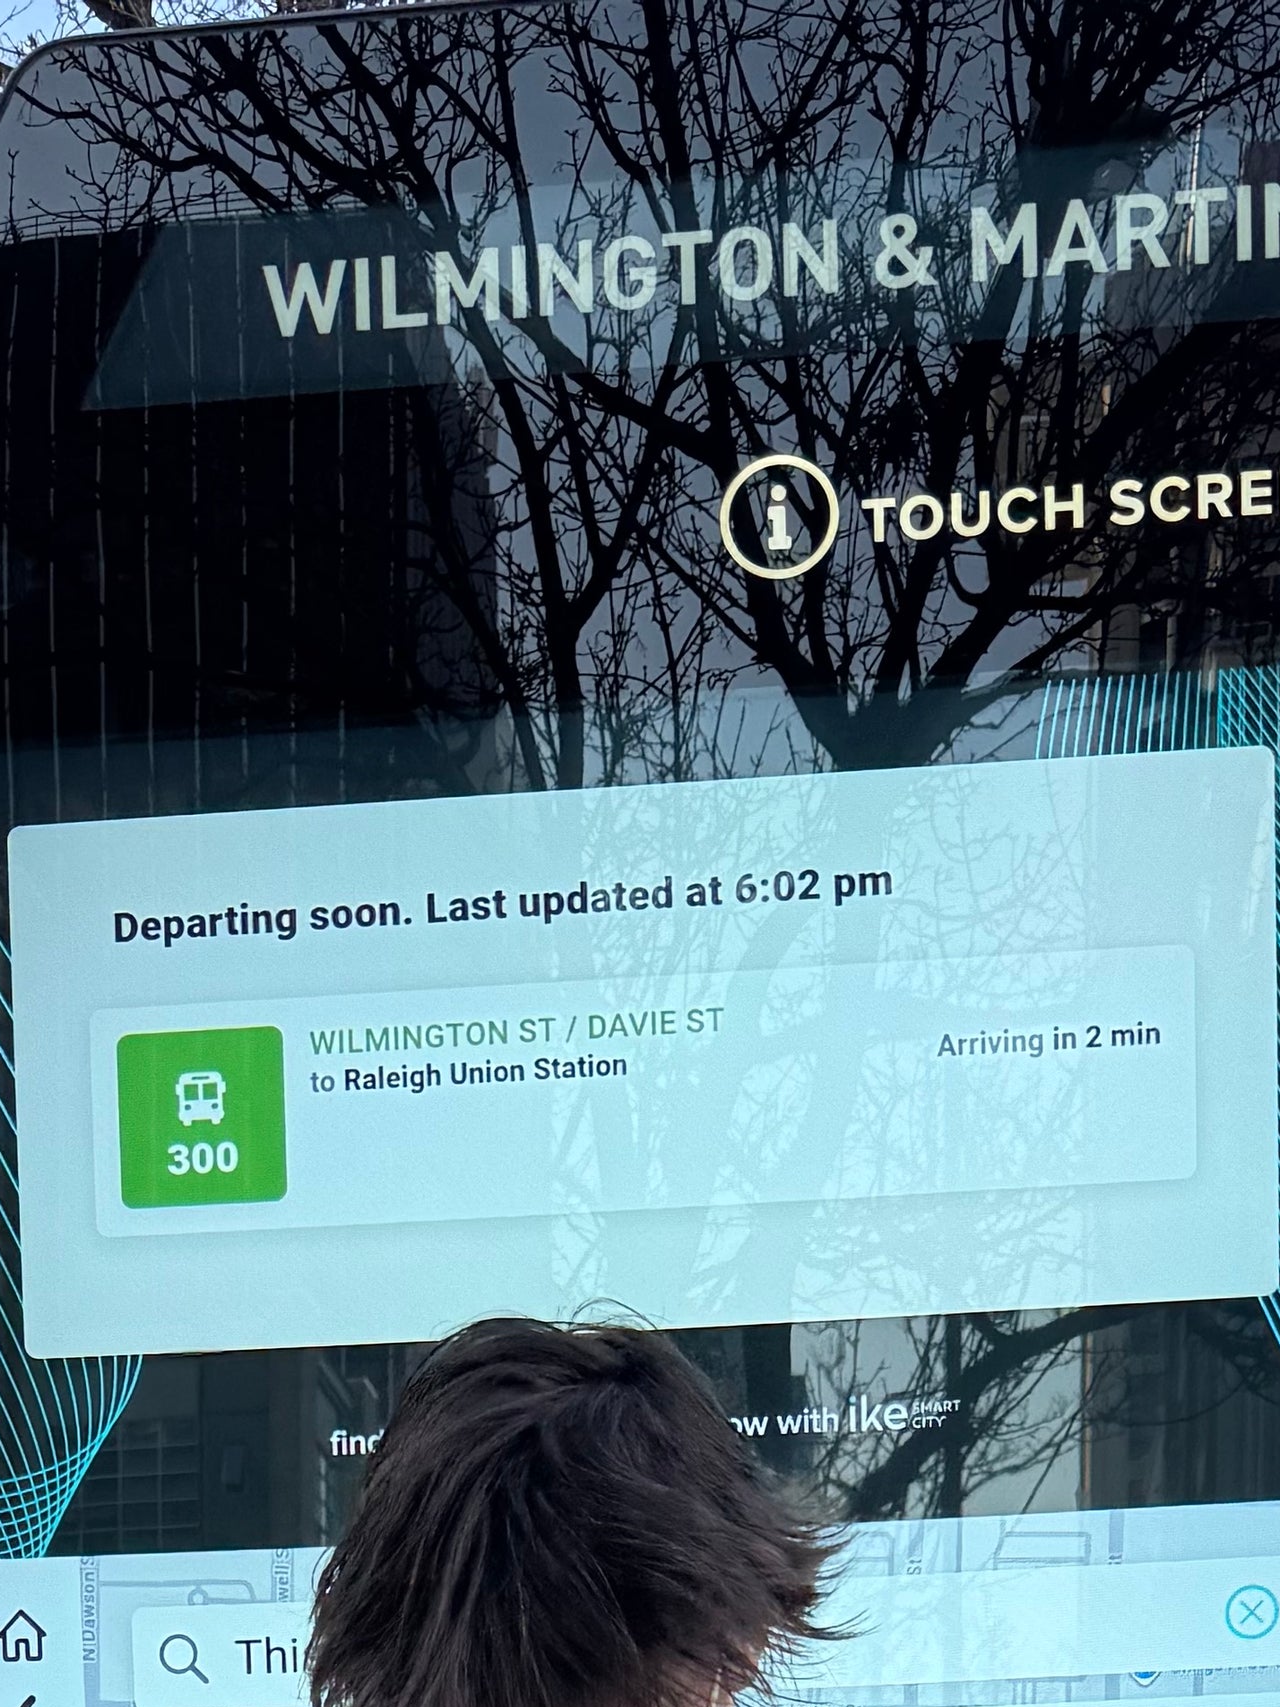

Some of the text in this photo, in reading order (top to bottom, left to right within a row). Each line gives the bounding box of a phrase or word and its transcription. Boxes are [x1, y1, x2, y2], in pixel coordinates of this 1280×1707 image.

[263, 219, 839, 337] WILMINGTON
[875, 212, 937, 289] &
[862, 484, 1085, 542] TOUCH
[114, 867, 894, 948] Departing soon. Last updated at 6:02 pm
[310, 1007, 725, 1058] WILMINGTON ST DAVIE ST
[937, 1022, 1161, 1059] Arriving in 2 min
[310, 1053, 628, 1096] to Raleigh Union Station
[167, 1141, 239, 1176] 300
[776, 1405, 839, 1435] with
[847, 1394, 909, 1433] ike
[911, 1416, 946, 1429] CITY
[912, 1399, 961, 1415] SMART
[81, 1570, 97, 1643] Dawson
